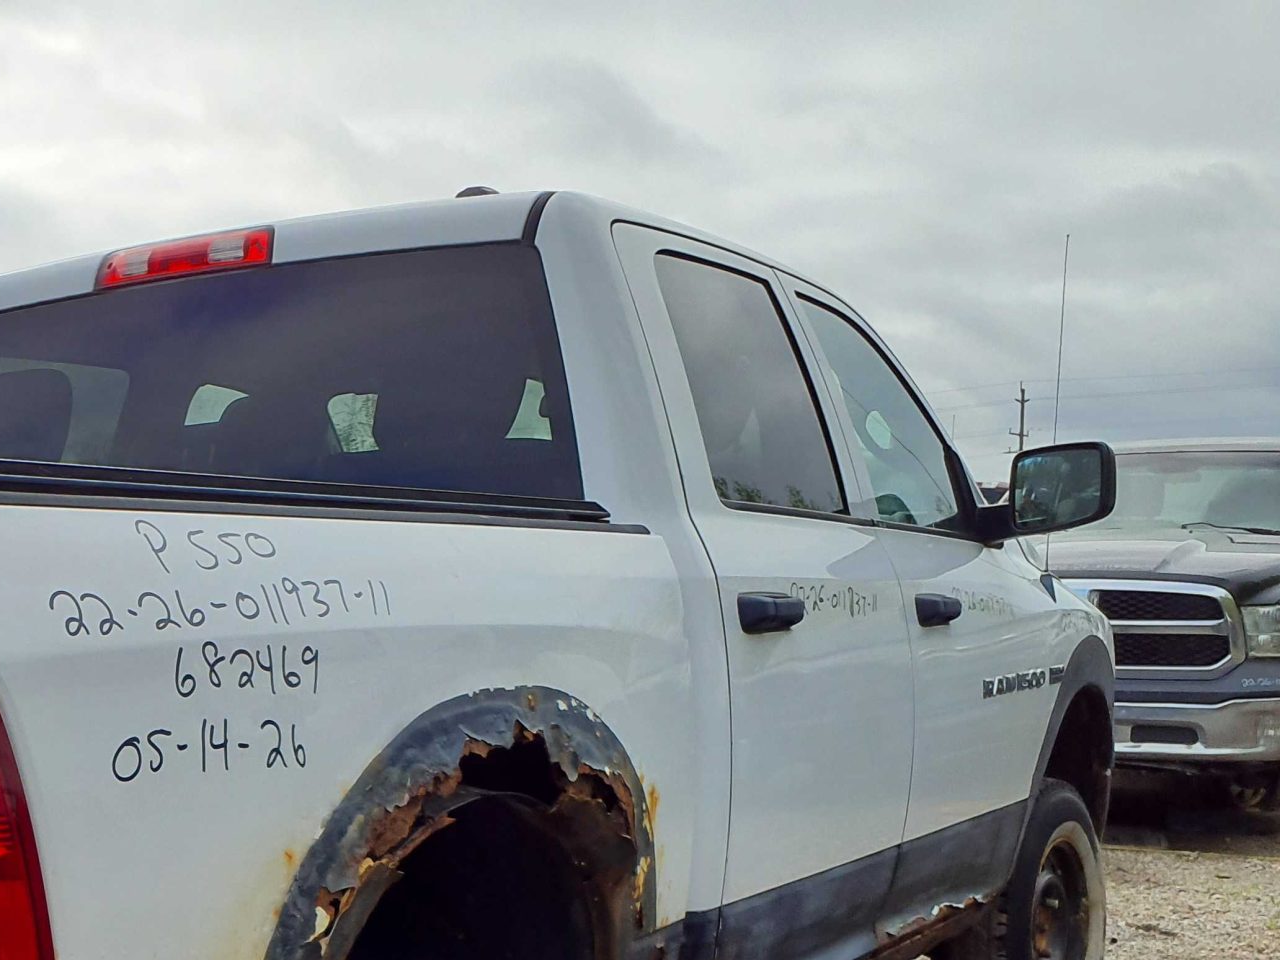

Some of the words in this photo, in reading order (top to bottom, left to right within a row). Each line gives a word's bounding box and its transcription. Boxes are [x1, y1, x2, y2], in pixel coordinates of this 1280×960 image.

[135, 519, 170, 574] P
[49, 576, 391, 636] 22-26-011937-11
[175, 641, 319, 698] 682469
[112, 718, 307, 782] 05-14-26
